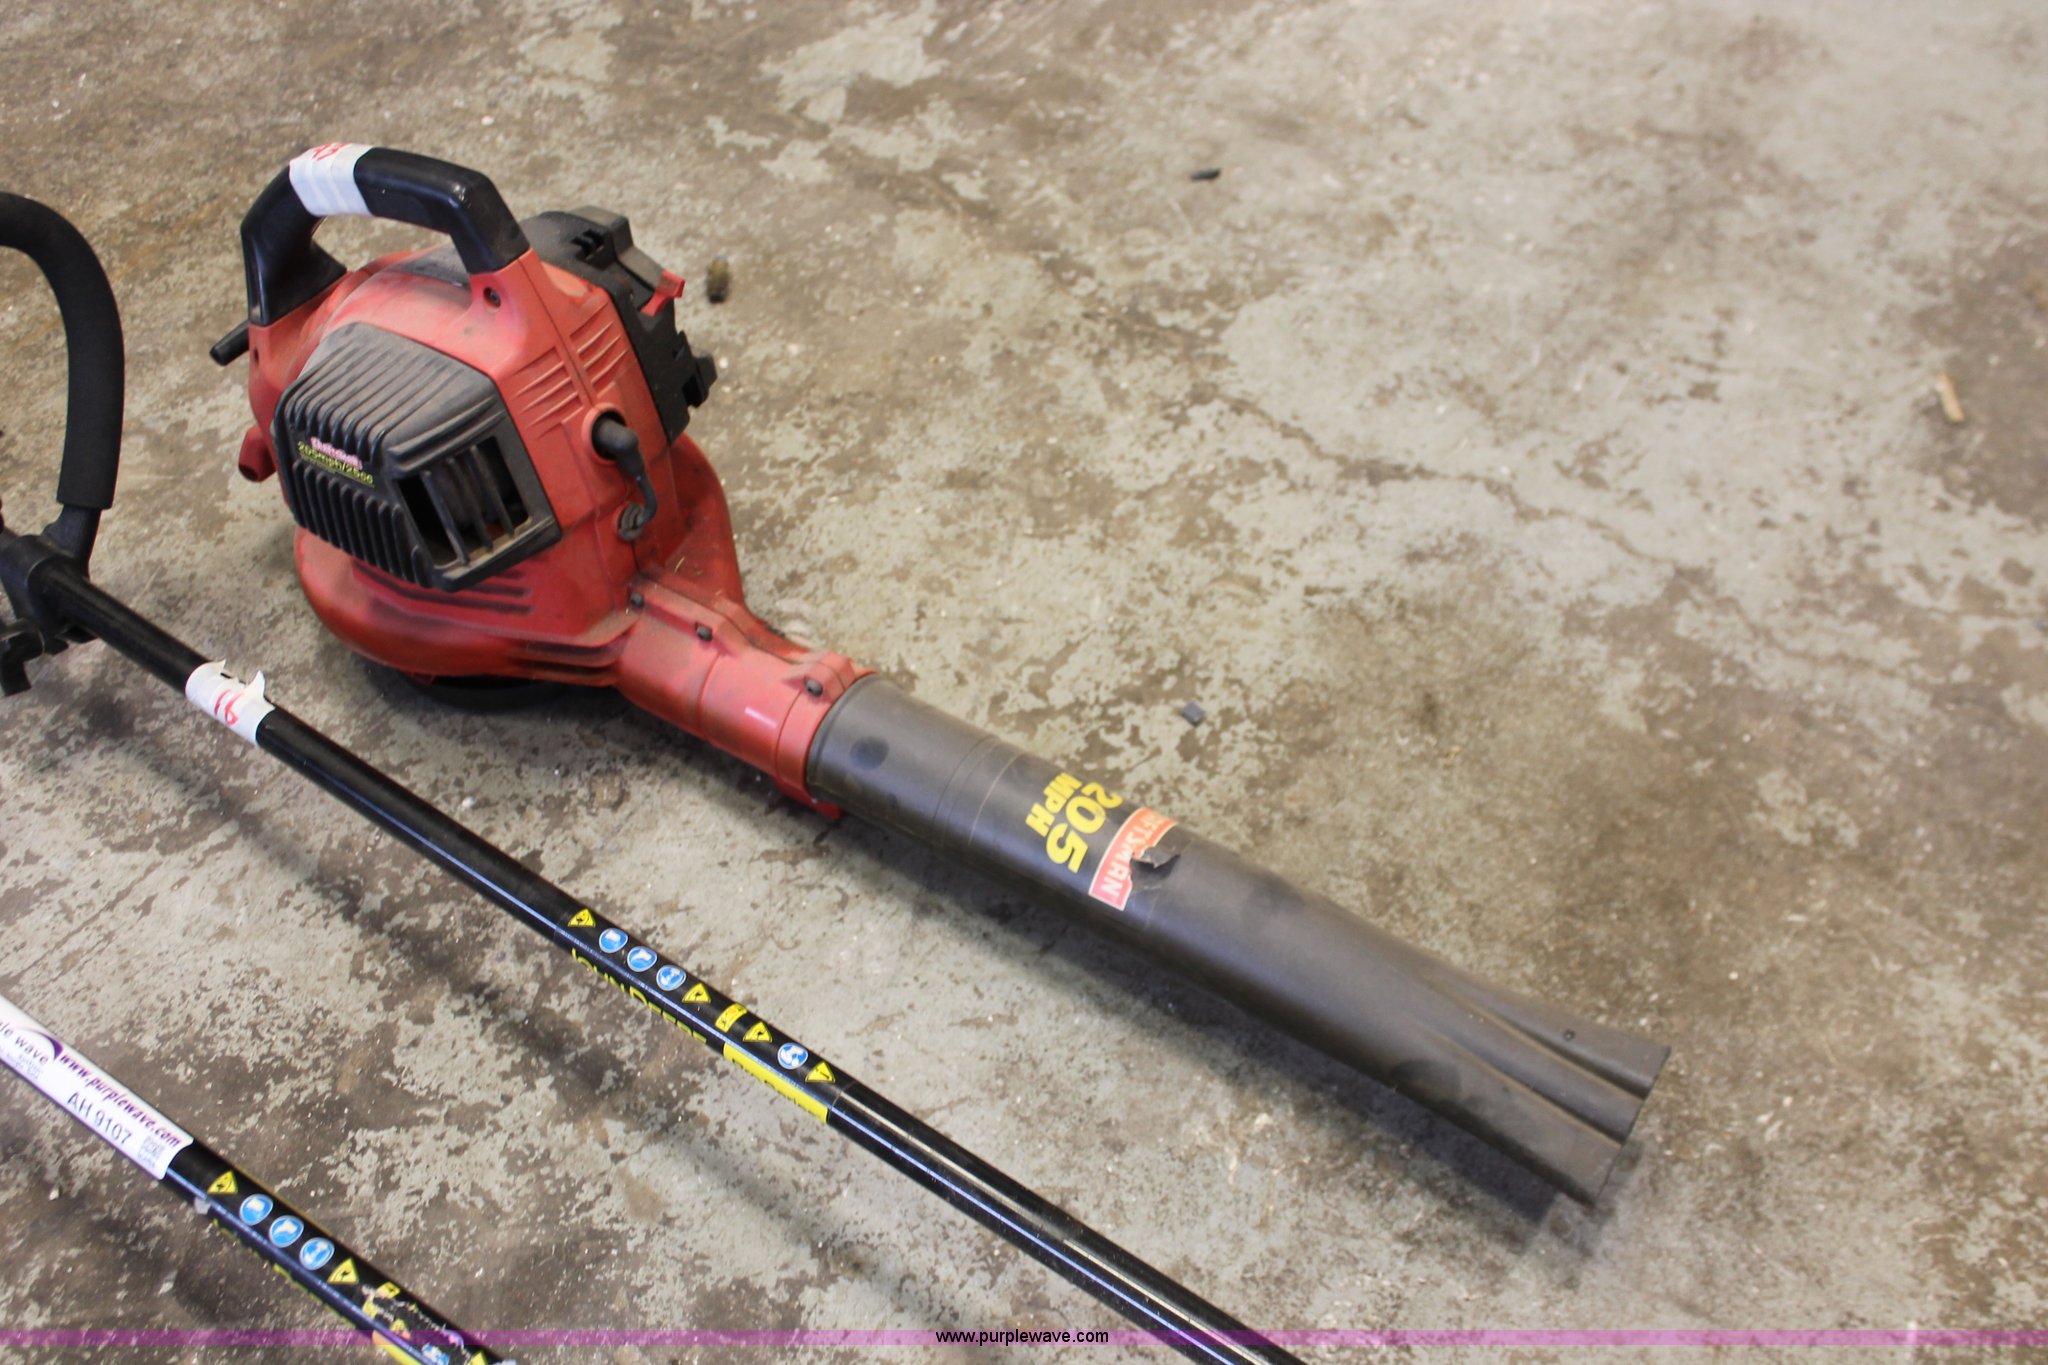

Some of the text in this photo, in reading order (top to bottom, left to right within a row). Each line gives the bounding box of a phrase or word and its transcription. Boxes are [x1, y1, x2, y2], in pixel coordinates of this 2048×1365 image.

[1025, 772, 1082, 837] MPH
[1046, 782, 1123, 874] 205
[15, 1036, 49, 1066] wave
[60, 1053, 182, 1148] www.purplewave.com
[67, 1091, 133, 1145] AH 9107
